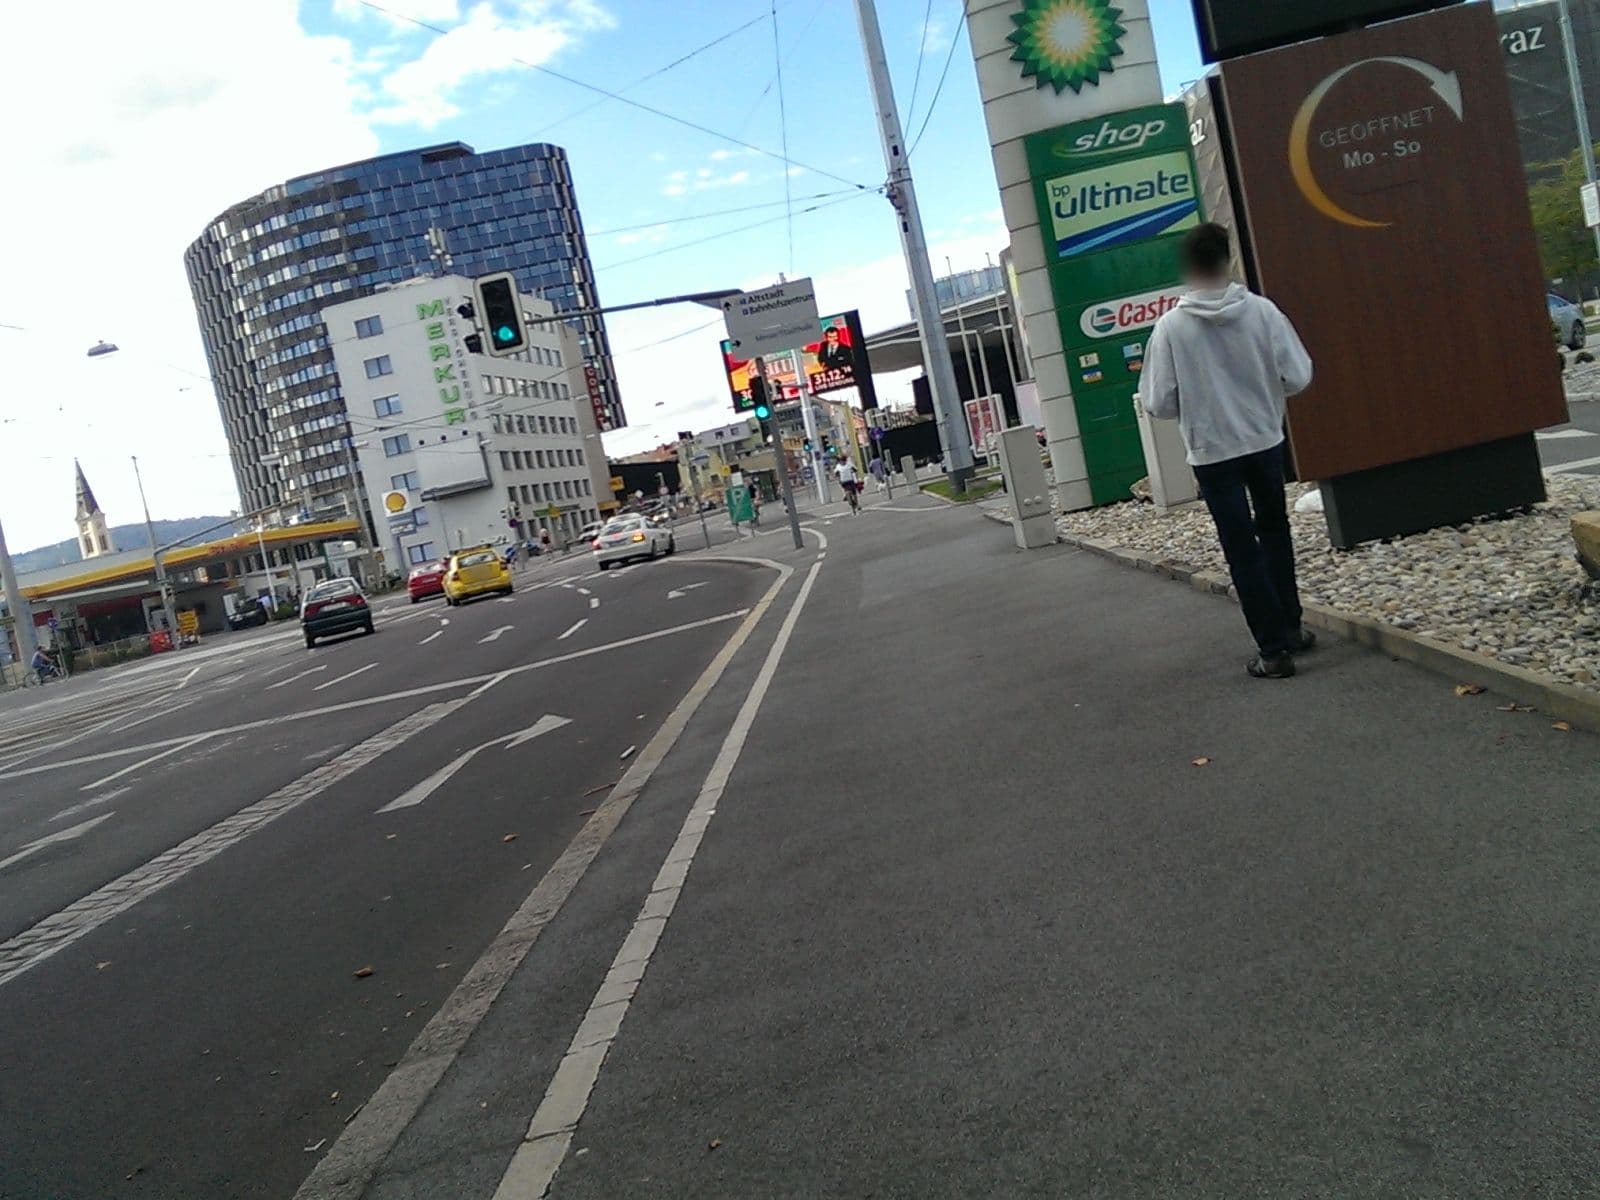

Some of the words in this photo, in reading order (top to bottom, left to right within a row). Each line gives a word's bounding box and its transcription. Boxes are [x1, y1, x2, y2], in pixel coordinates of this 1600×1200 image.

[1075, 120, 1165, 149] shop
[1342, 150, 1375, 169] Mo
[1393, 140, 1421, 157] So
[1051, 184, 1070, 198] bp
[1055, 169, 1190, 219] ultimate
[1118, 295, 1180, 328] Castr
[416, 299, 466, 426] MERKUR
